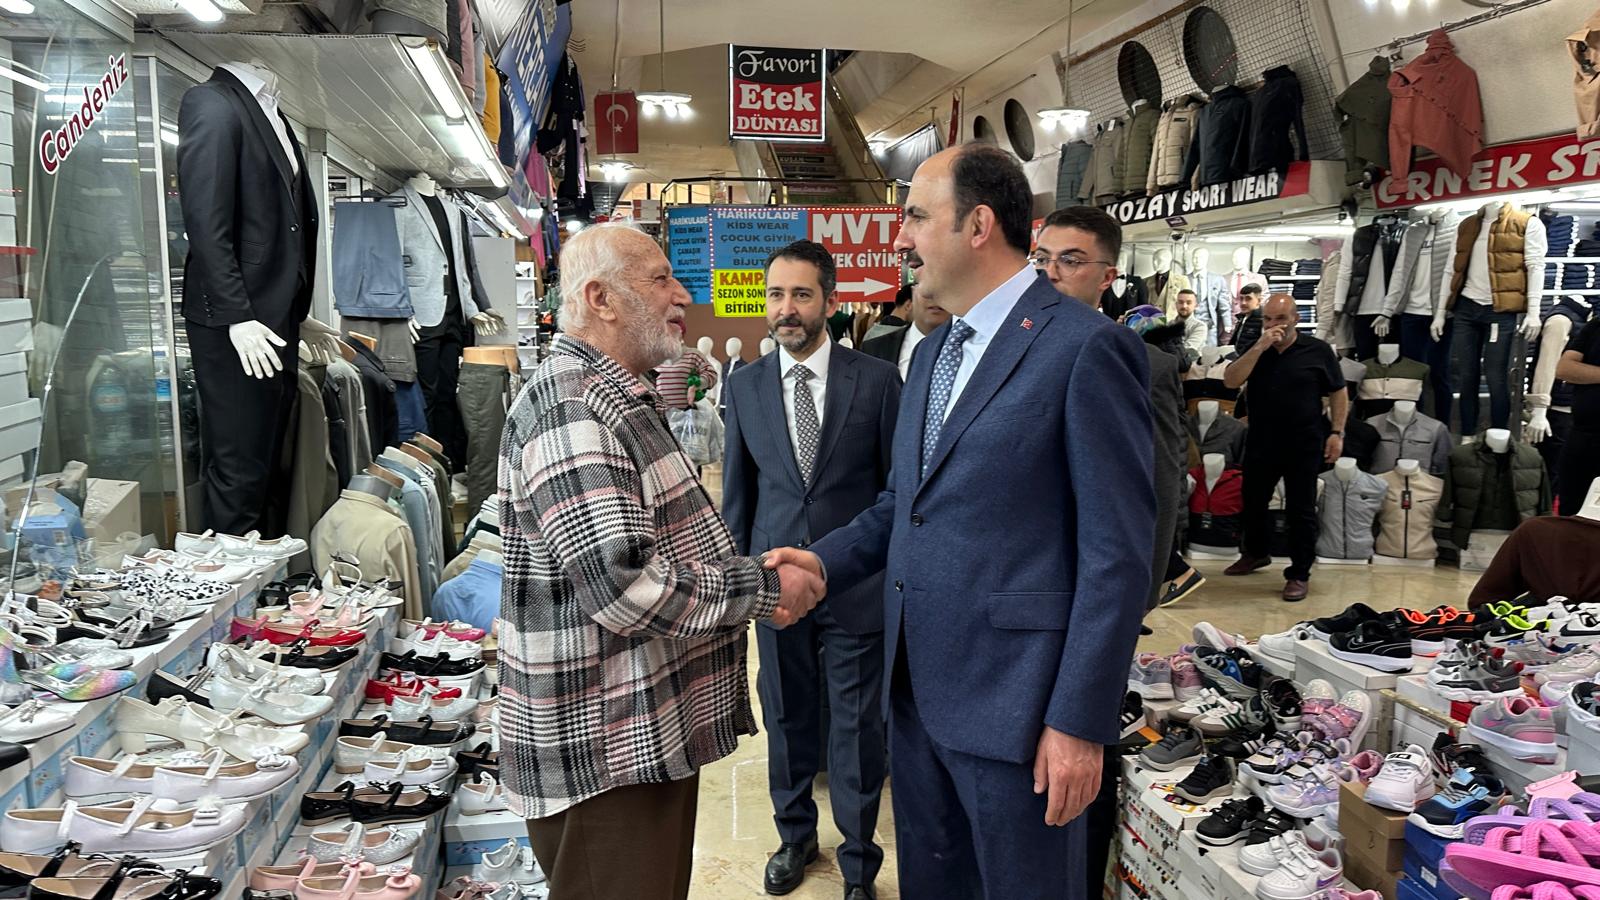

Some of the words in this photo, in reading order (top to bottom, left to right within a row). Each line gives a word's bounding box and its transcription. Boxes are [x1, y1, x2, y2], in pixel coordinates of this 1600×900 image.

[737, 50, 817, 77] Favori
[739, 83, 816, 112] Etek
[39, 53, 128, 174] Candeniz
[737, 114, 818, 132] DÜNYASI
[1105, 190, 1179, 223] KOZAY
[1182, 182, 1228, 212] SPORT
[1232, 171, 1279, 203] WEAR
[756, 222, 789, 230] WEAR
[812, 213, 898, 245] MVT
[720, 234, 760, 243] ÇOCUK
[733, 257, 765, 266] BİJUT
[857, 248, 898, 268] GİYİM
[719, 272, 765, 286] KAMP
[717, 288, 744, 299] SEZON
[725, 301, 766, 313] BİTİRİY
